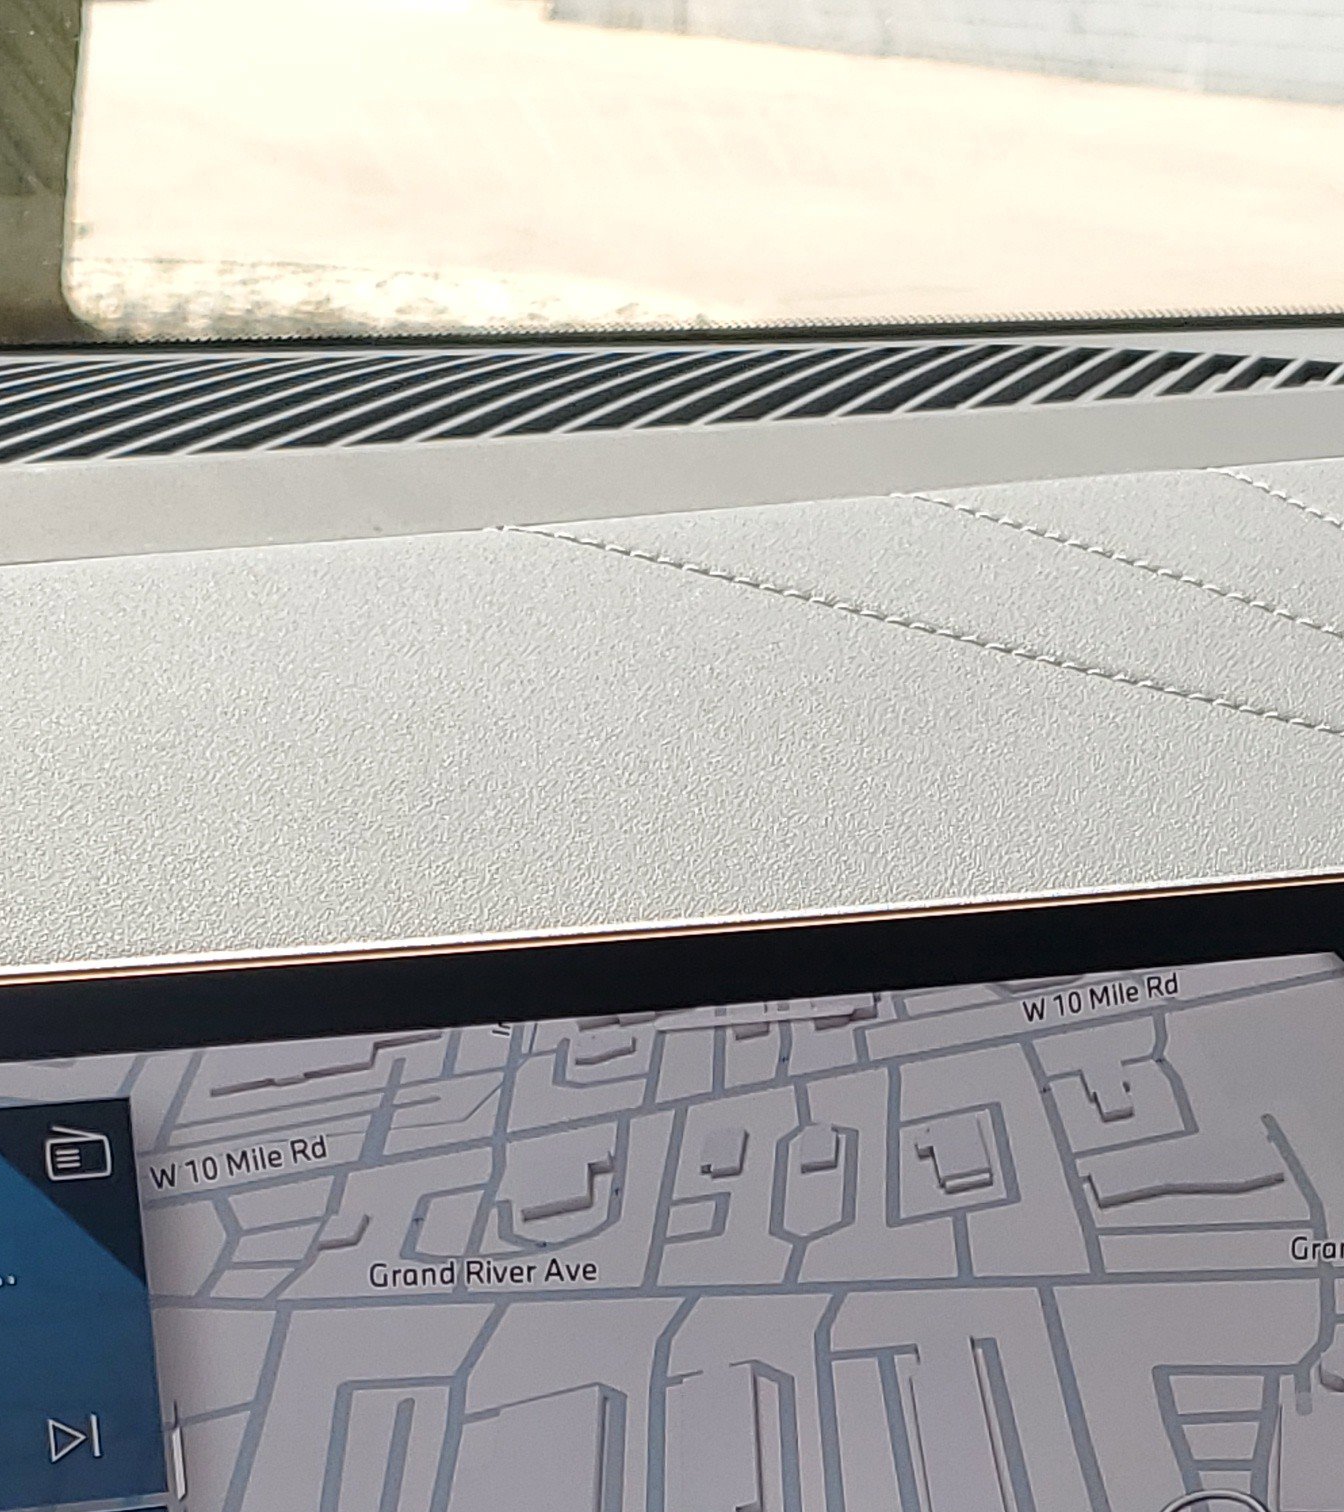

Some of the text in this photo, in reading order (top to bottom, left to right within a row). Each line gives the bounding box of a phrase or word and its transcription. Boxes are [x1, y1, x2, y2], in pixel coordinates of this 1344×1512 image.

[1022, 972, 1178, 1022] W 10 Mile Rd
[150, 1135, 328, 1190] W 10 Mile Rd
[369, 1258, 598, 1289] Grand River Ave
